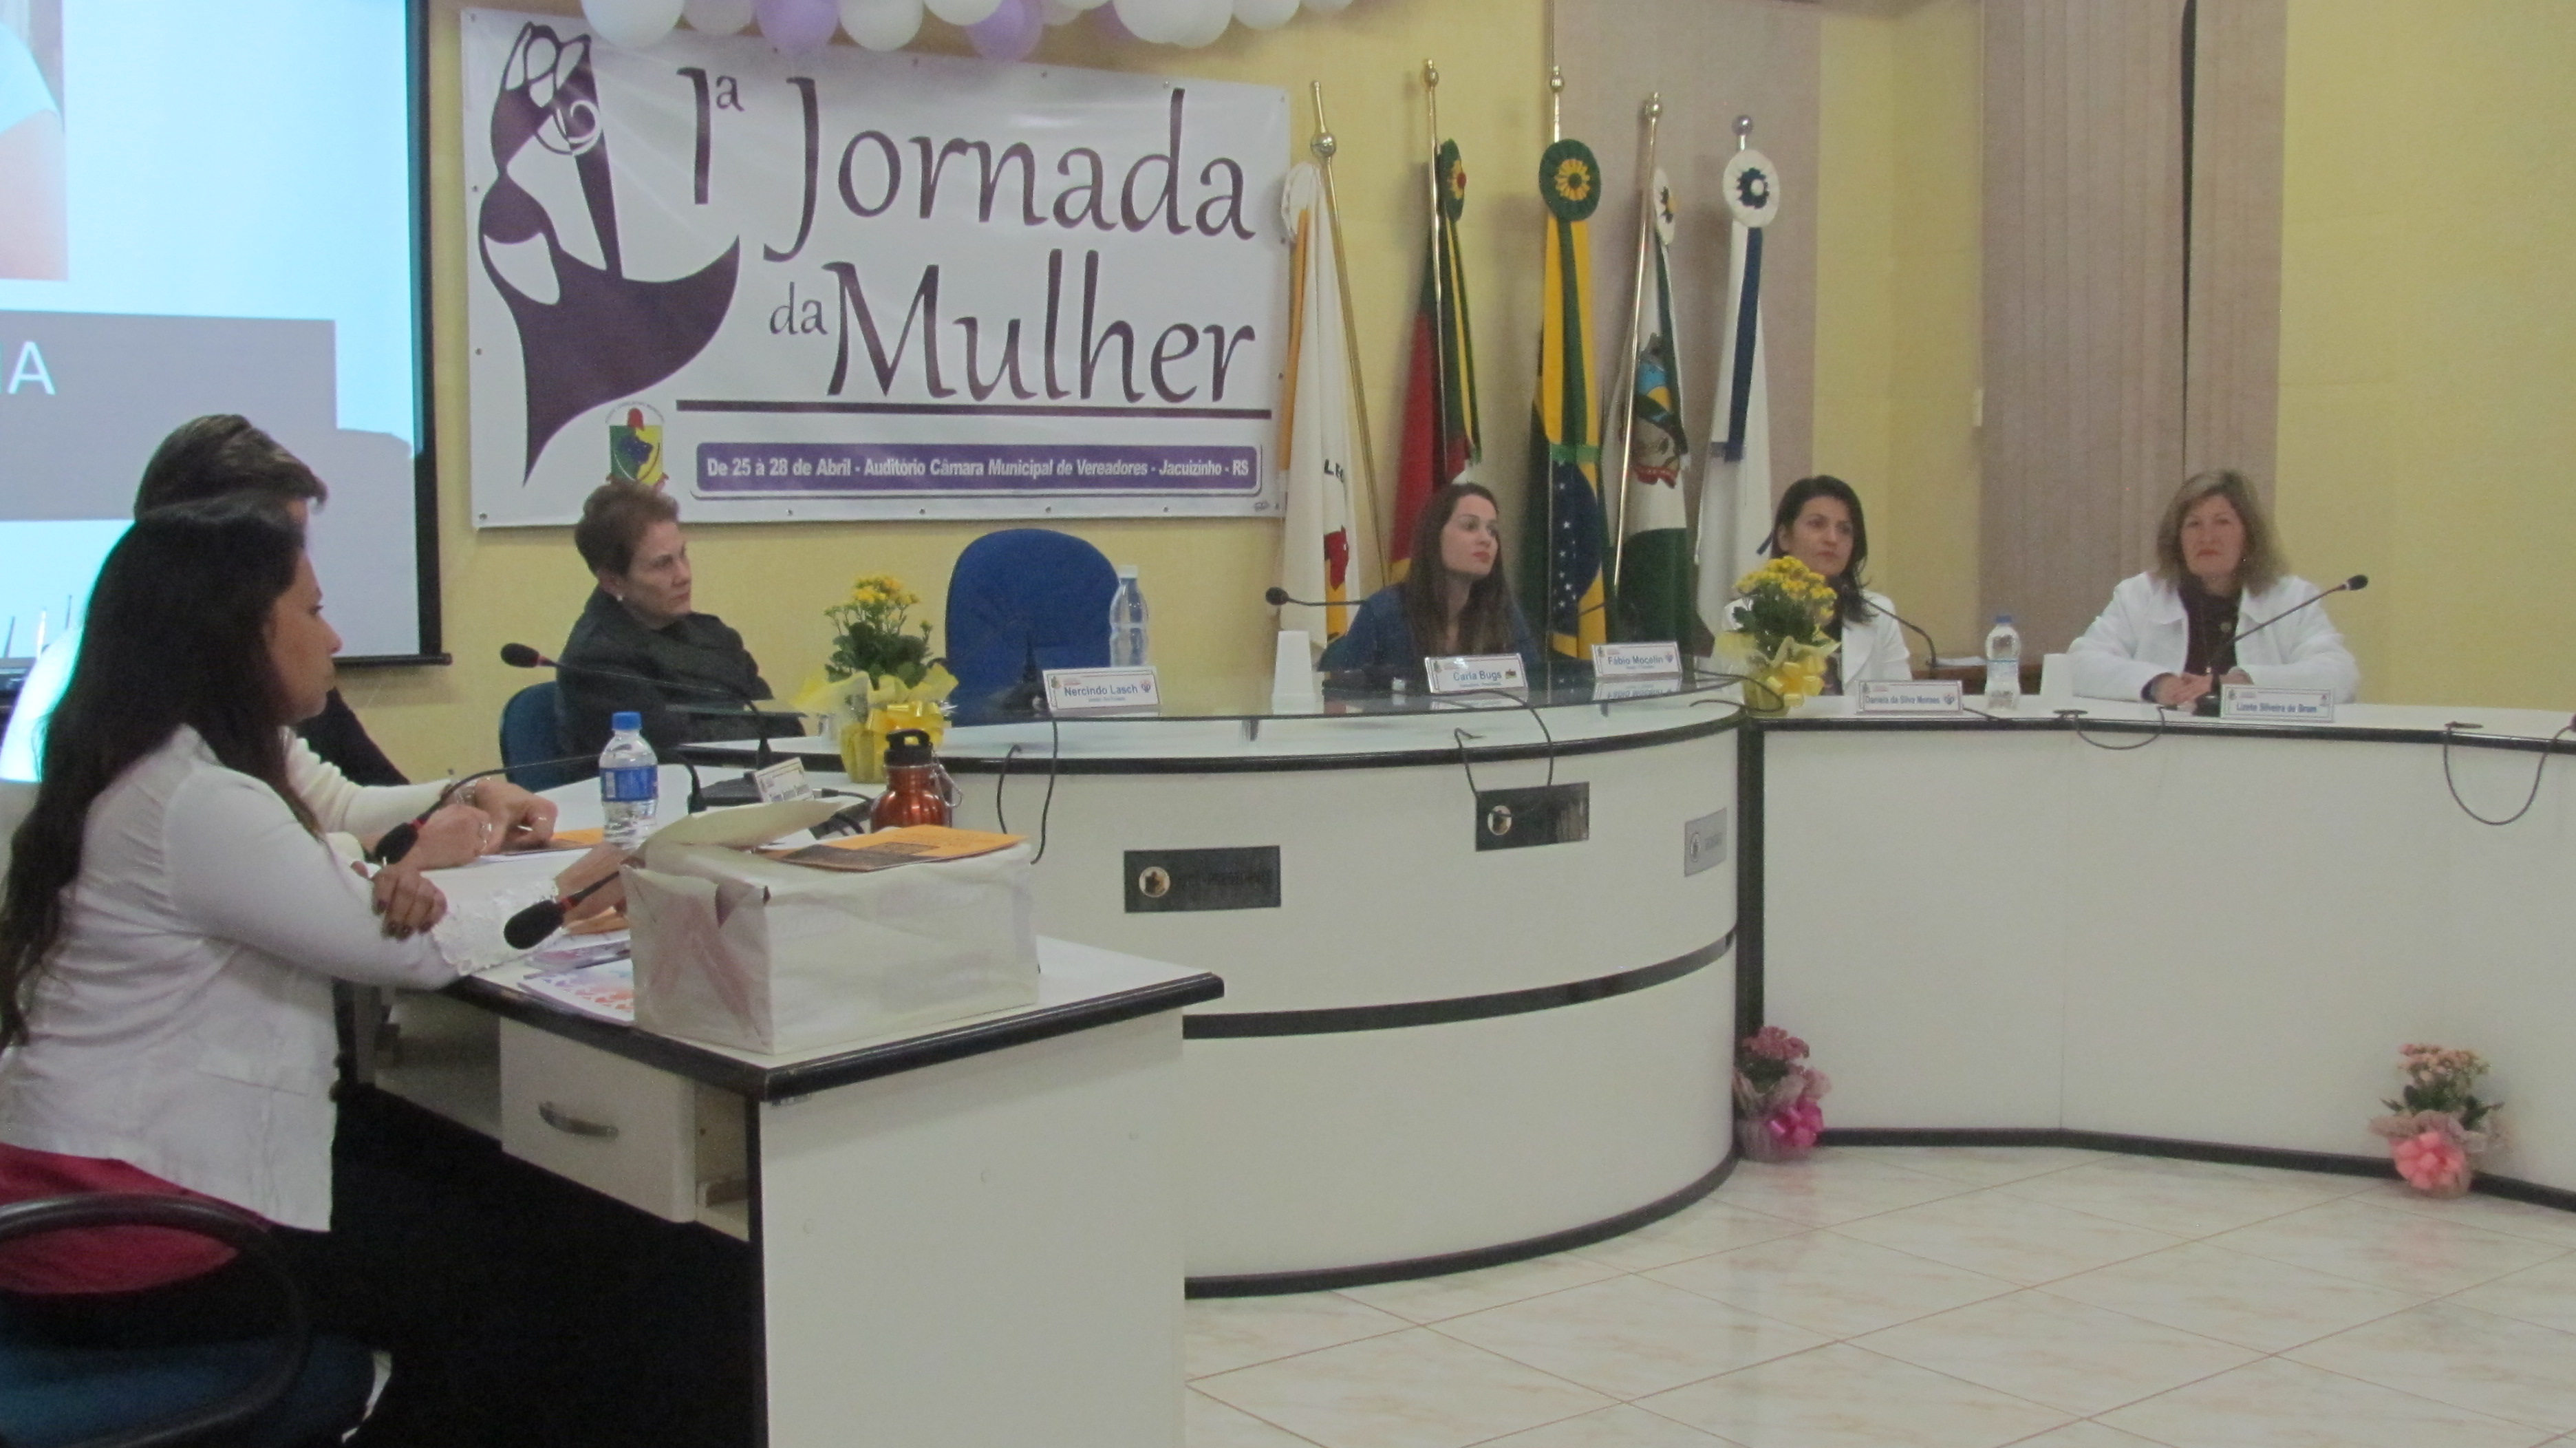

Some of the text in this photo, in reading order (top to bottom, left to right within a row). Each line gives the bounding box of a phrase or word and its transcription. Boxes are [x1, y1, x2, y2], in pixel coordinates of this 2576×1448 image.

[763, 76, 1256, 262] Jornada
[769, 248, 1256, 403] da Mulher
[707, 458, 728, 476] De
[732, 458, 751, 476] 25
[755, 457, 764, 476] à
[769, 458, 788, 476] 28
[793, 458, 811, 476] de
[816, 458, 851, 476] Abril
[864, 458, 925, 477] Auditório
[930, 457, 984, 476] Câmara
[988, 458, 1053, 480] Municipal
[1056, 459, 1073, 476] de
[1076, 458, 1148, 476] Vereadores
[1159, 458, 1222, 476] Jacuizinho
[1232, 459, 1249, 476] RS
[1632, 654, 1664, 665] Mocelin
[1452, 670, 1502, 681] Carla Bugs
[1064, 683, 1138, 696] Nercindo Lasch
